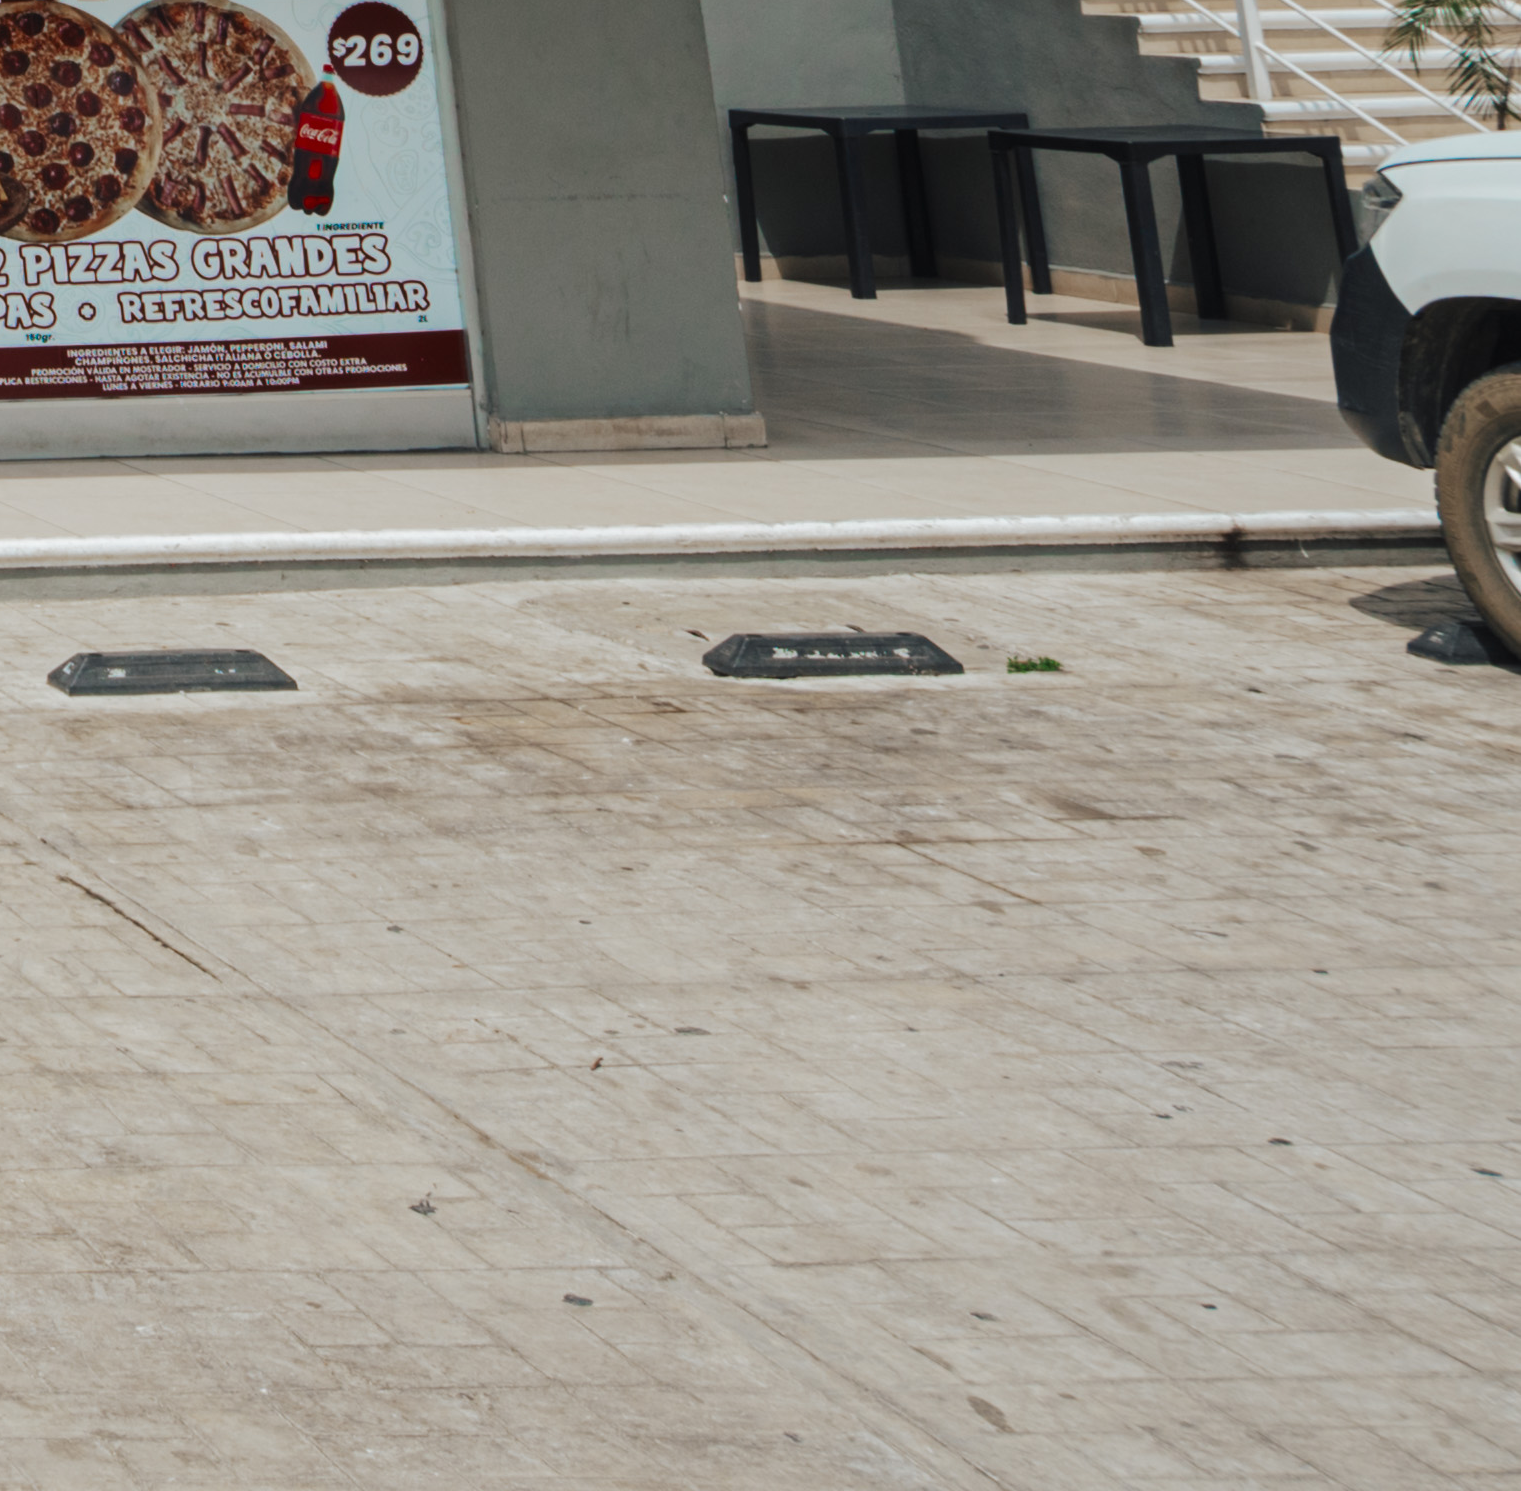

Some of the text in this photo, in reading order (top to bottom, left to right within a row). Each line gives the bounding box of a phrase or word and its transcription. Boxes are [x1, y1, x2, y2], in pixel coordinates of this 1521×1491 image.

[332, 32, 421, 67] $269
[19, 240, 181, 286] PIZZAS
[191, 233, 392, 281] GRANDES
